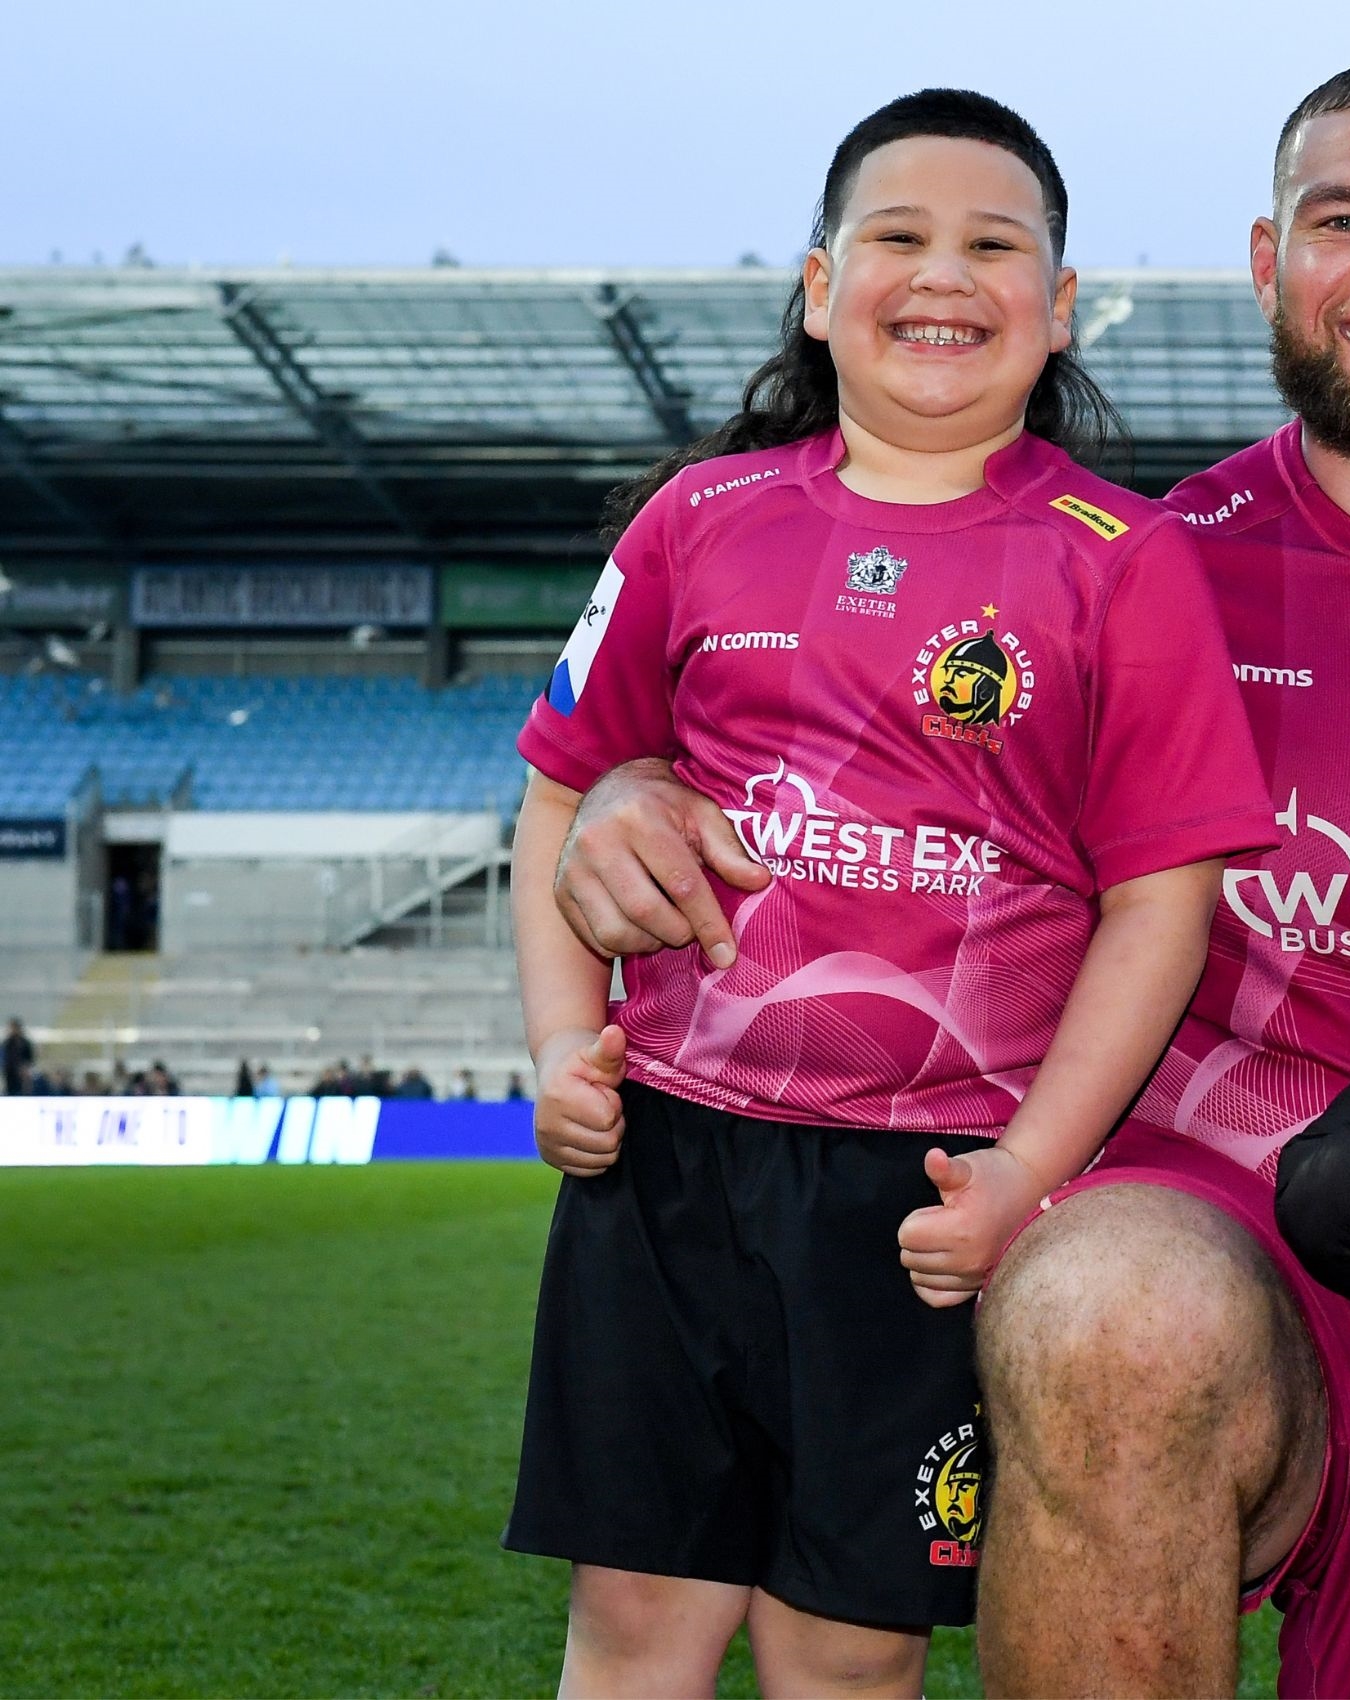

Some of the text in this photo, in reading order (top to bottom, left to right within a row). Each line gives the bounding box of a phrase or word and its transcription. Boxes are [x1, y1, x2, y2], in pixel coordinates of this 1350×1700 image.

[703, 468, 781, 499] SAMURAI
[1068, 503, 1118, 535] Bradfords
[836, 605, 857, 613] LIVE
[837, 596, 897, 612] EXETER
[721, 631, 800, 650] comms
[912, 620, 979, 705] EXETER
[1001, 631, 1035, 727] RUGBY
[921, 714, 1003, 755] Chiefs
[746, 811, 1008, 873] WEST EXE
[911, 871, 985, 897] PARK
[915, 1424, 974, 1531] EXETER
